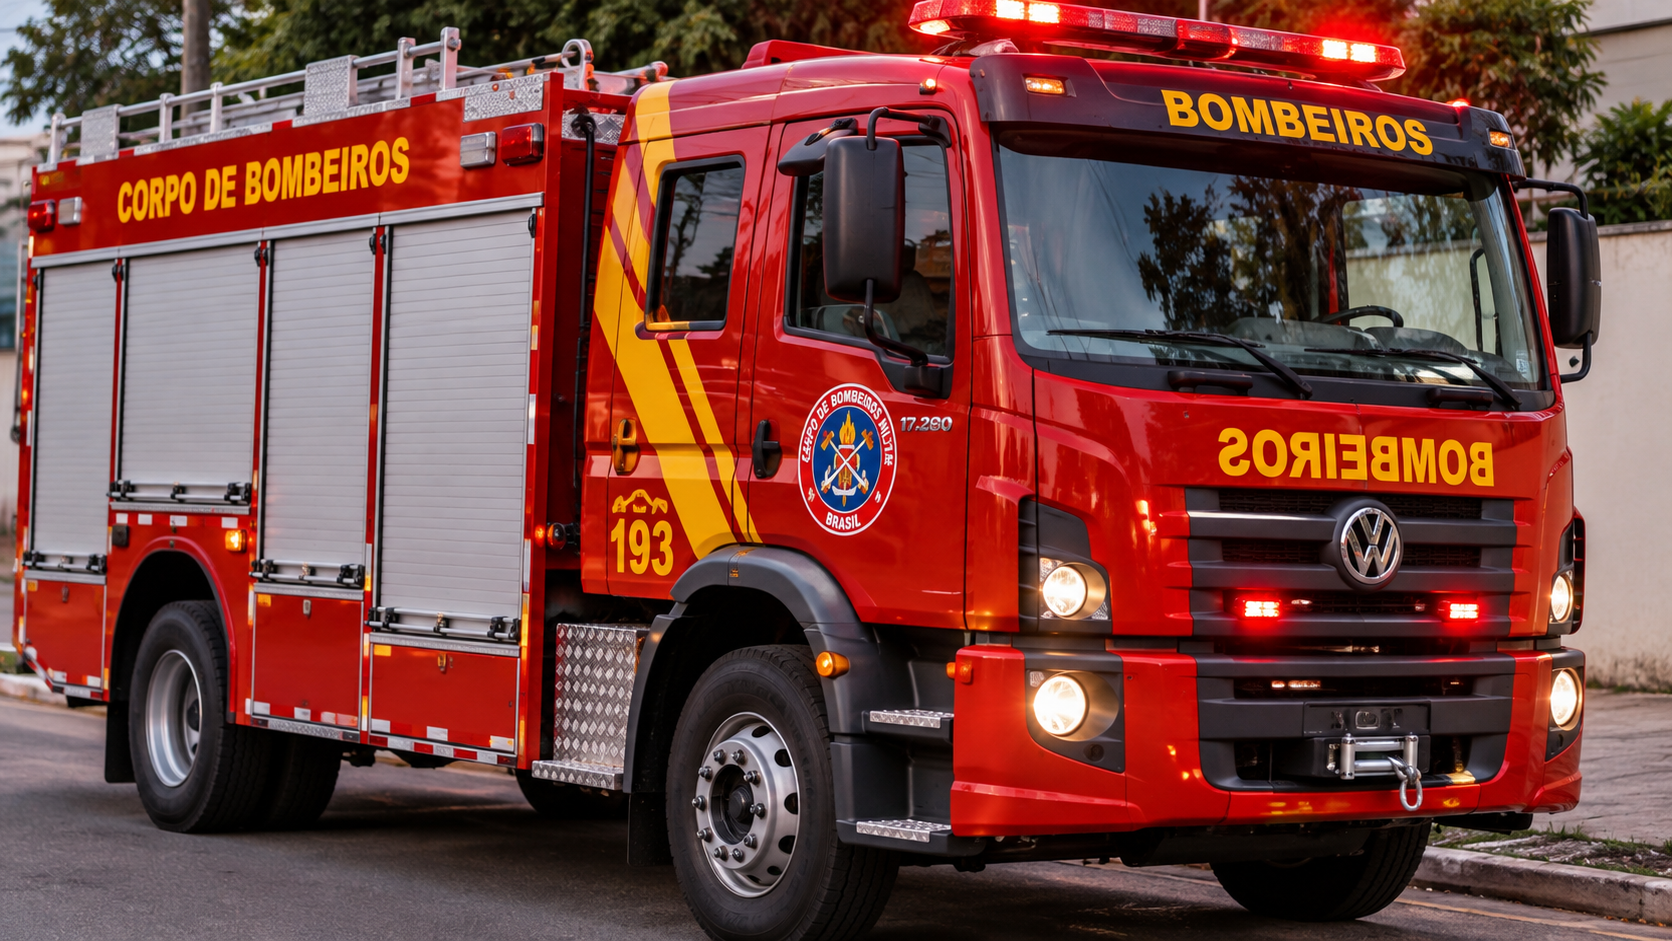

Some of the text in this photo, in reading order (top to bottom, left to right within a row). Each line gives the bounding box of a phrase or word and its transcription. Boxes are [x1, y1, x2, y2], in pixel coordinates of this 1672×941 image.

[1161, 89, 1433, 156] BOMBEIROS
[117, 137, 410, 223] CORPO DE BOMBEIROS
[816, 400, 830, 419] DE
[610, 518, 674, 576] 193
[825, 511, 862, 530] BRASIL
[1343, 510, 1398, 581] VW
